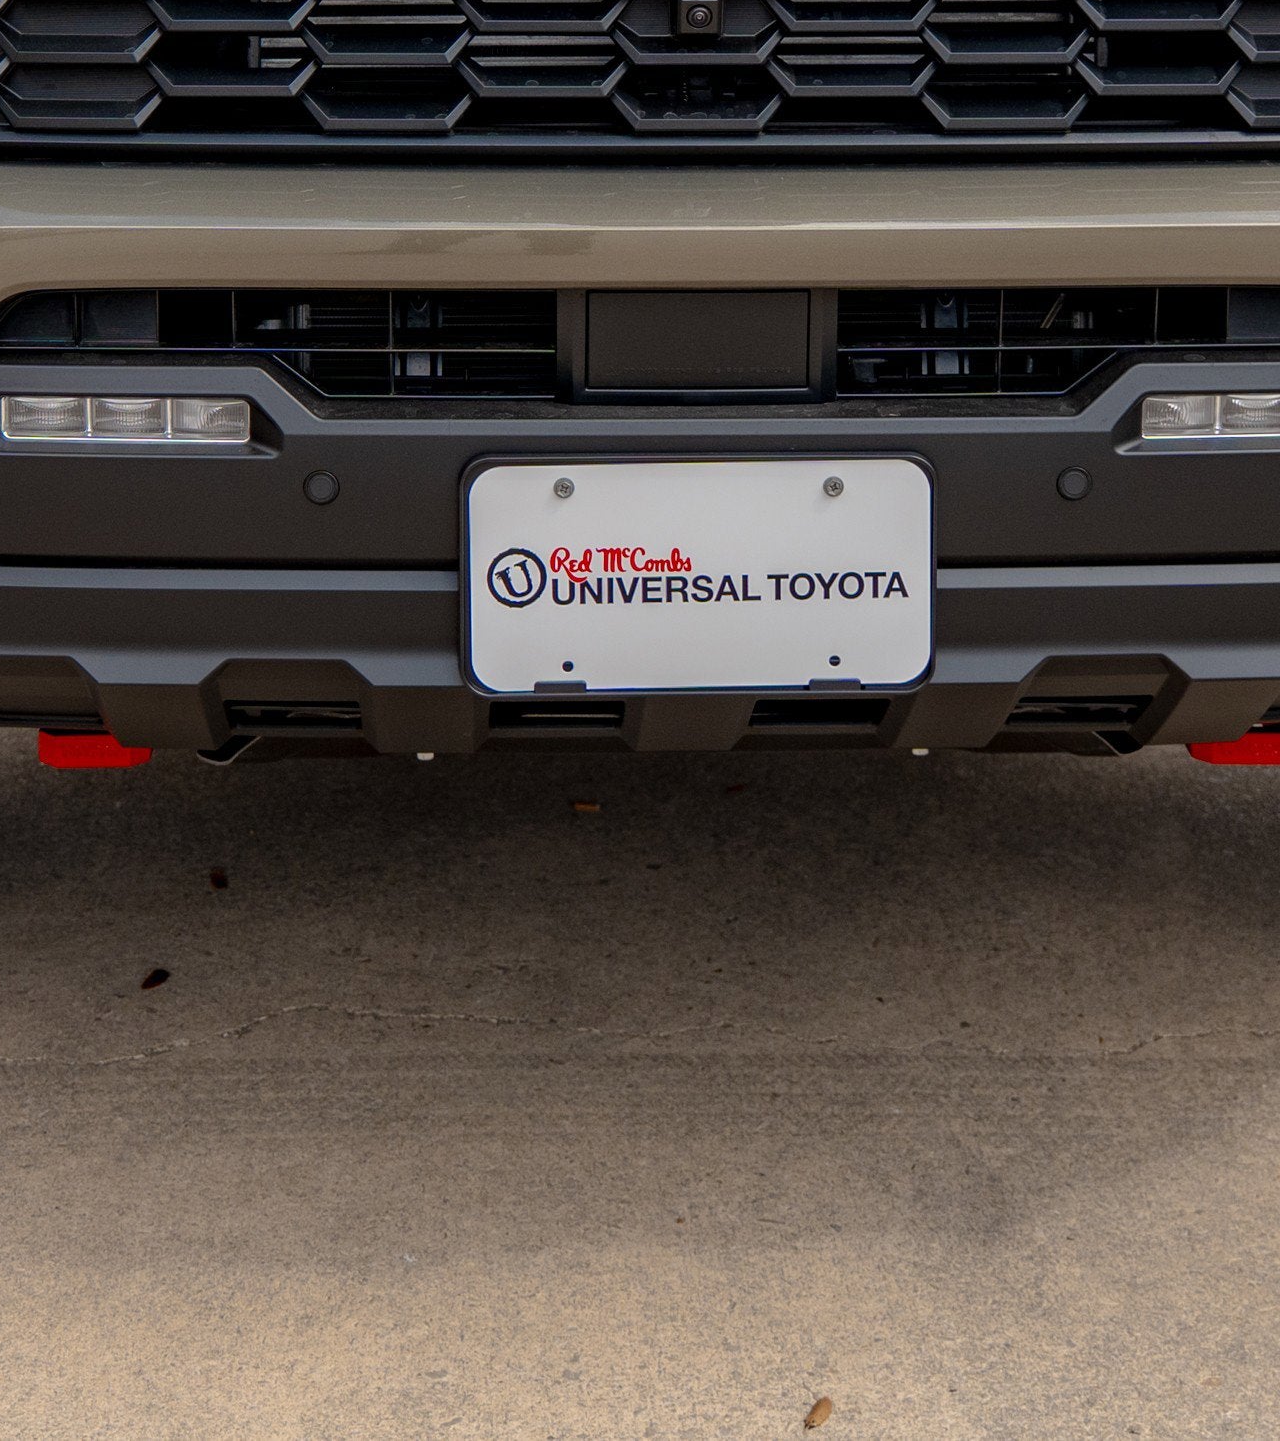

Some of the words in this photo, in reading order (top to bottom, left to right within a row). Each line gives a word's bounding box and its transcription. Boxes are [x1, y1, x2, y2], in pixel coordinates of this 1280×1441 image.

[549, 547, 593, 583] Red
[596, 547, 692, 573] McCombs
[551, 574, 762, 605] UNIVERSAL
[767, 571, 909, 601] TOYOTA
